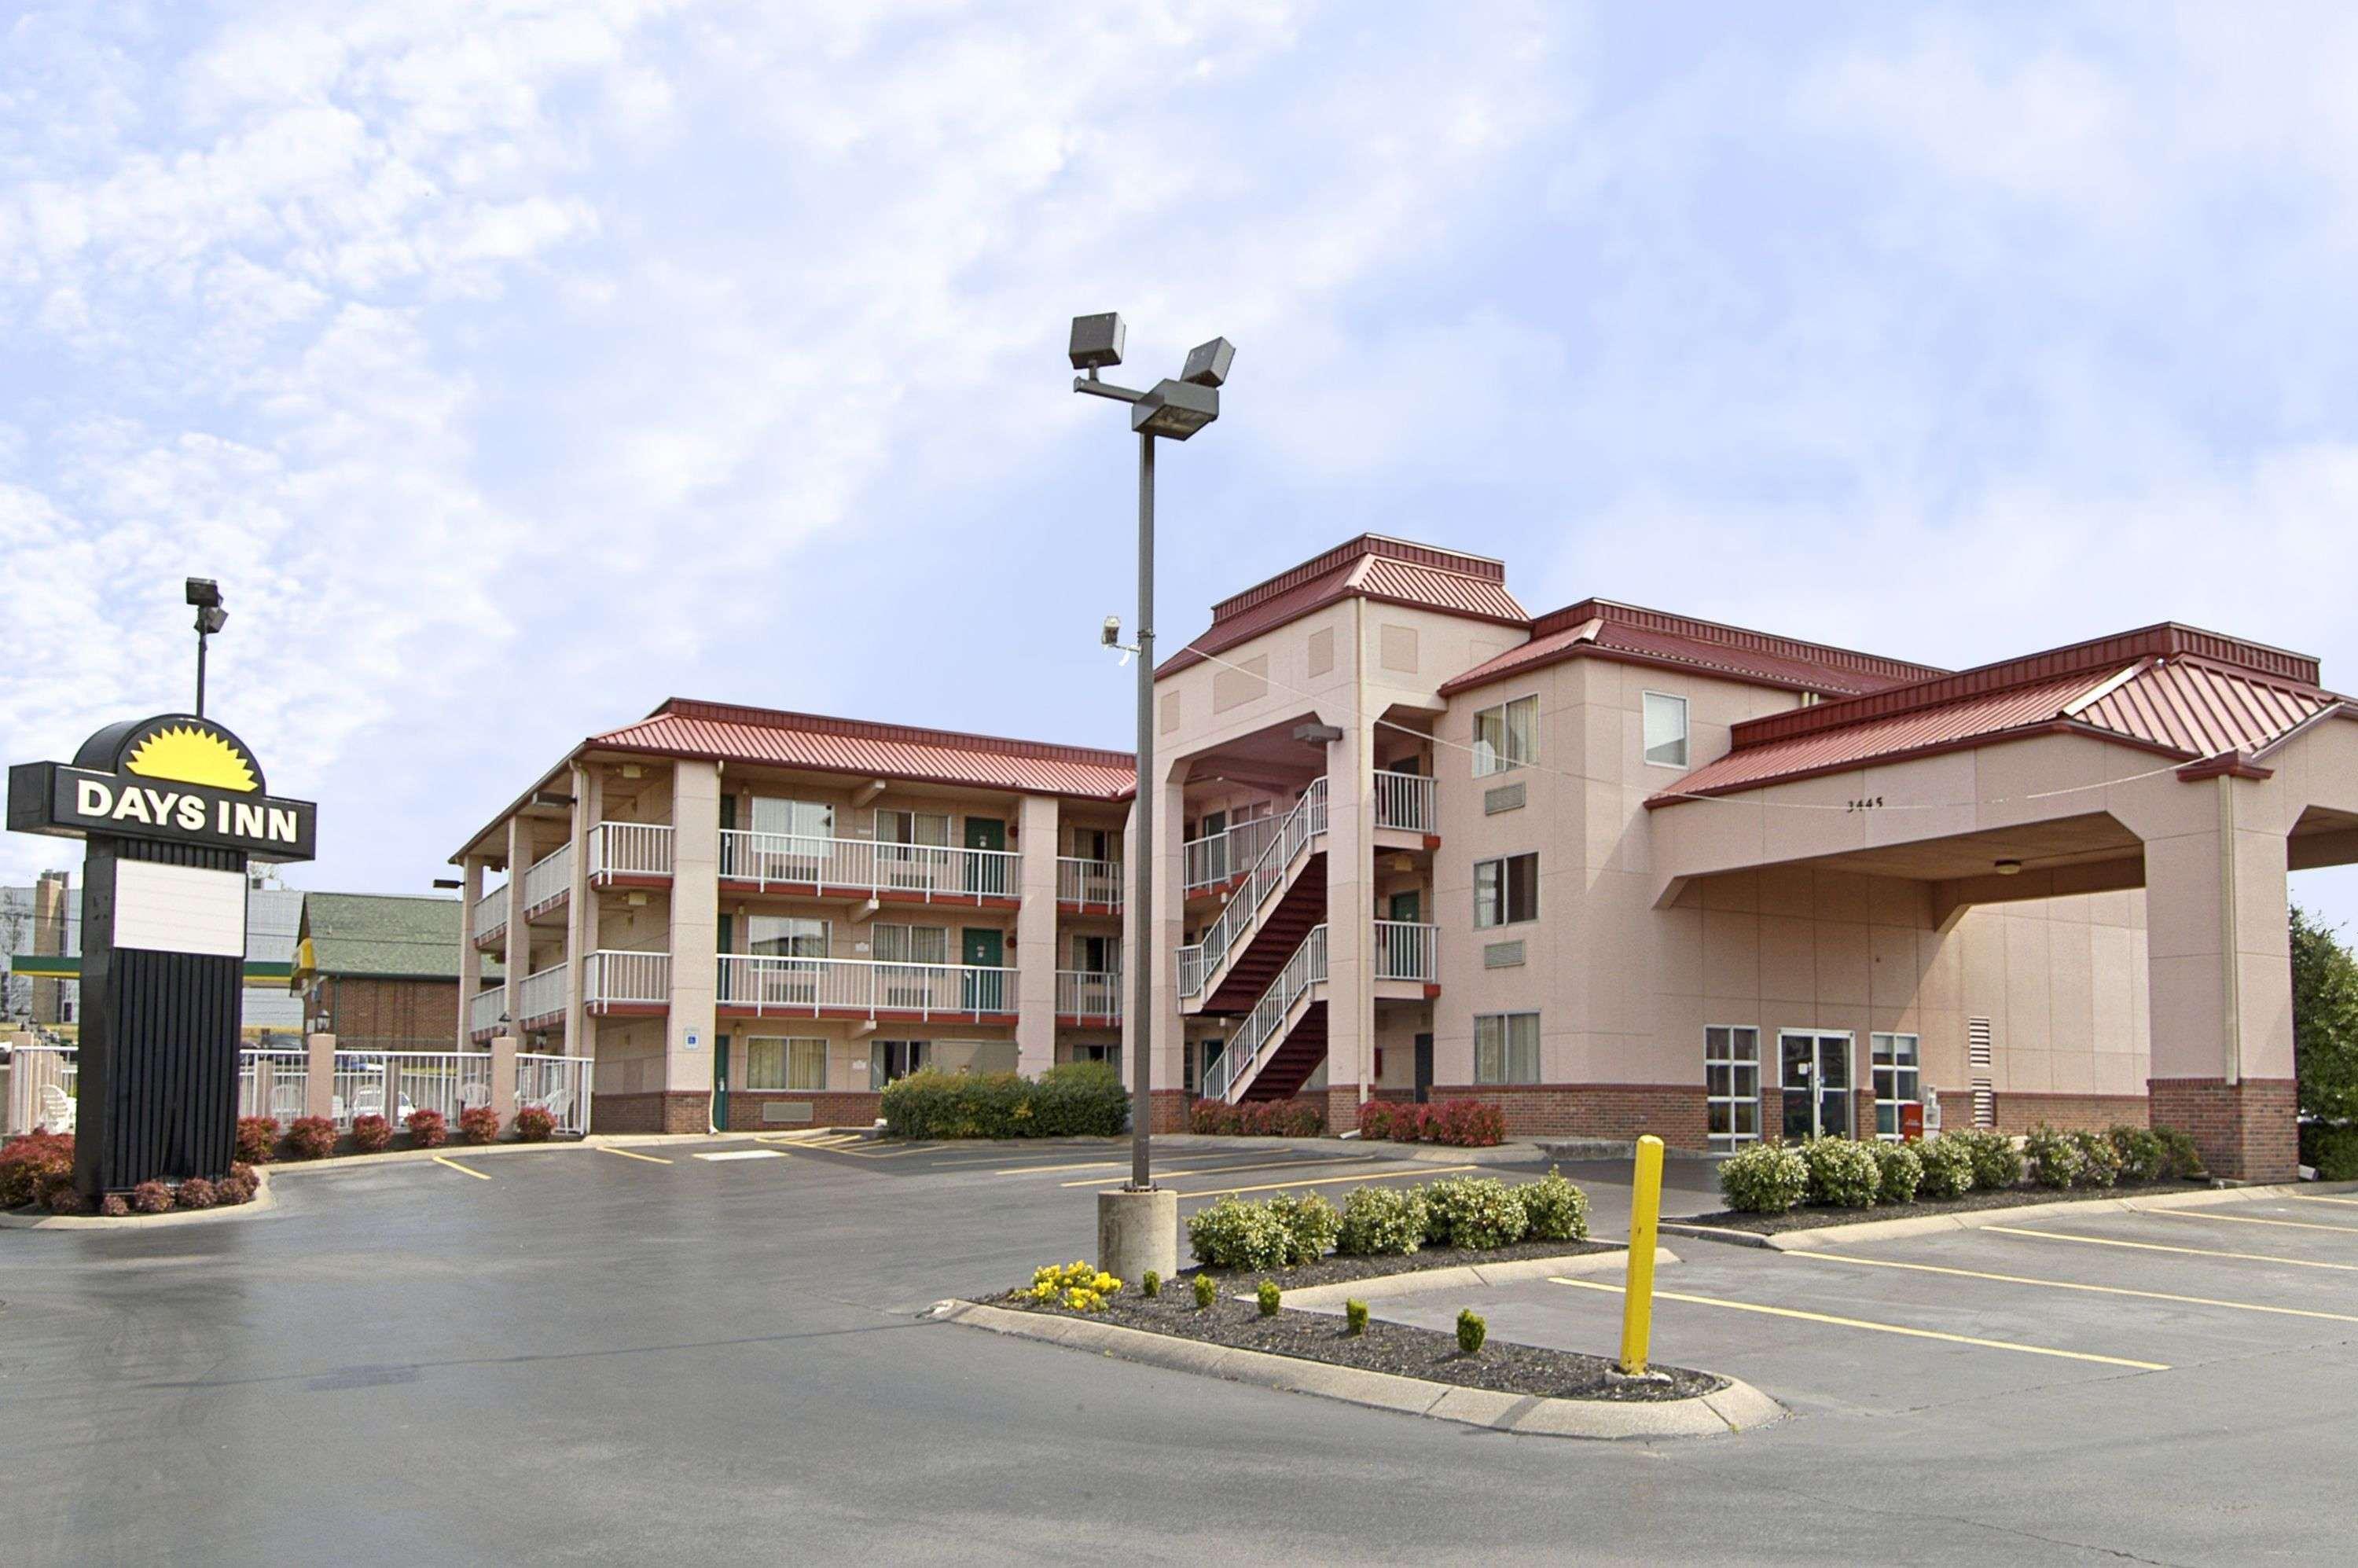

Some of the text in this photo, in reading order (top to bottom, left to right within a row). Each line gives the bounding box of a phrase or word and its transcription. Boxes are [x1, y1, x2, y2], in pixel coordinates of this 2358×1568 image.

[78, 779, 297, 843] DAYS INN
[1847, 796, 1882, 813] 3445
